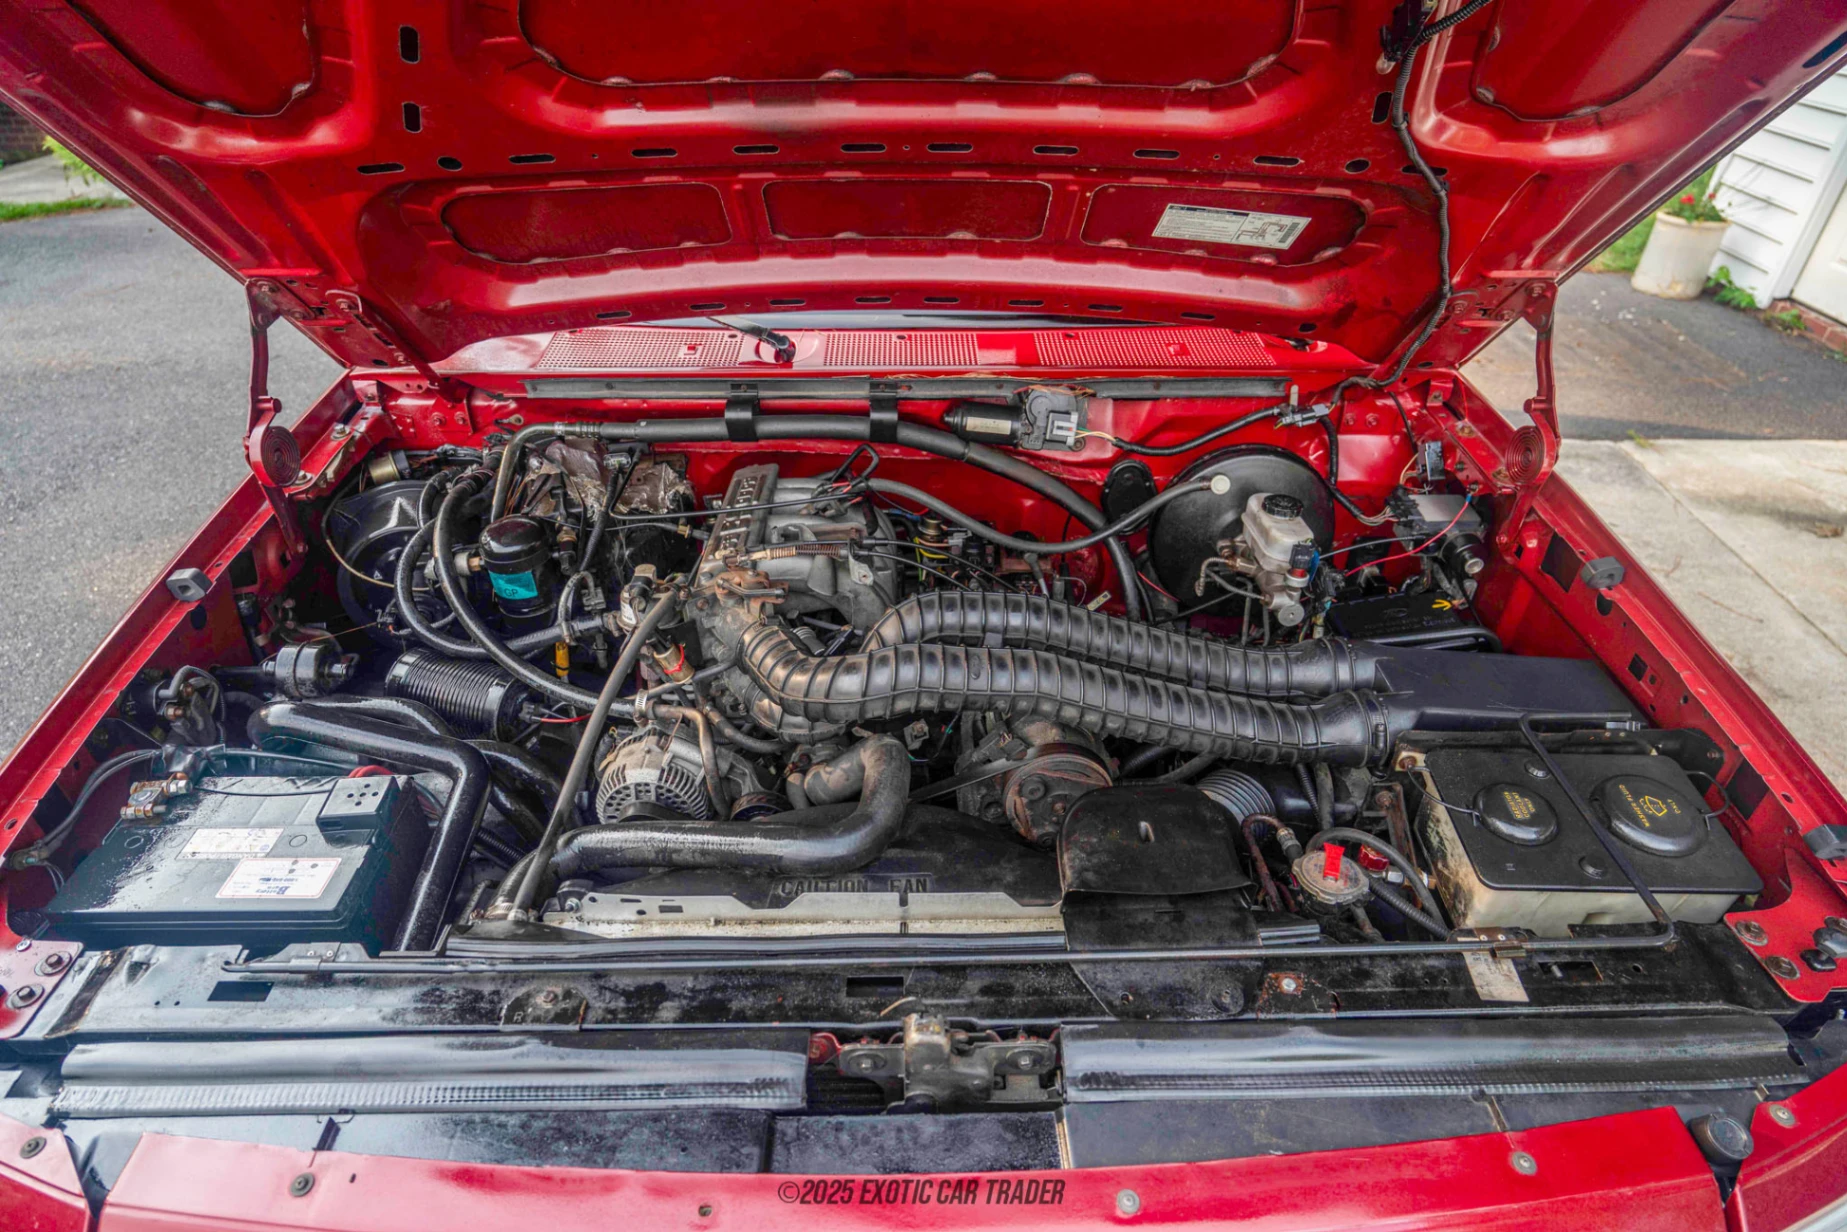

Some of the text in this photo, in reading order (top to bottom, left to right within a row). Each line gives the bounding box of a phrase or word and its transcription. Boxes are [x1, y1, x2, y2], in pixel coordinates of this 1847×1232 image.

[1503, 791, 1522, 819] RADIATOR
[1512, 791, 1530, 818] COOLANT
[1524, 798, 1535, 812] ONLY
[1619, 784, 1650, 827] WASHER FLUID
[1667, 799, 1681, 814] ONLY
[889, 878, 929, 893] FAN
